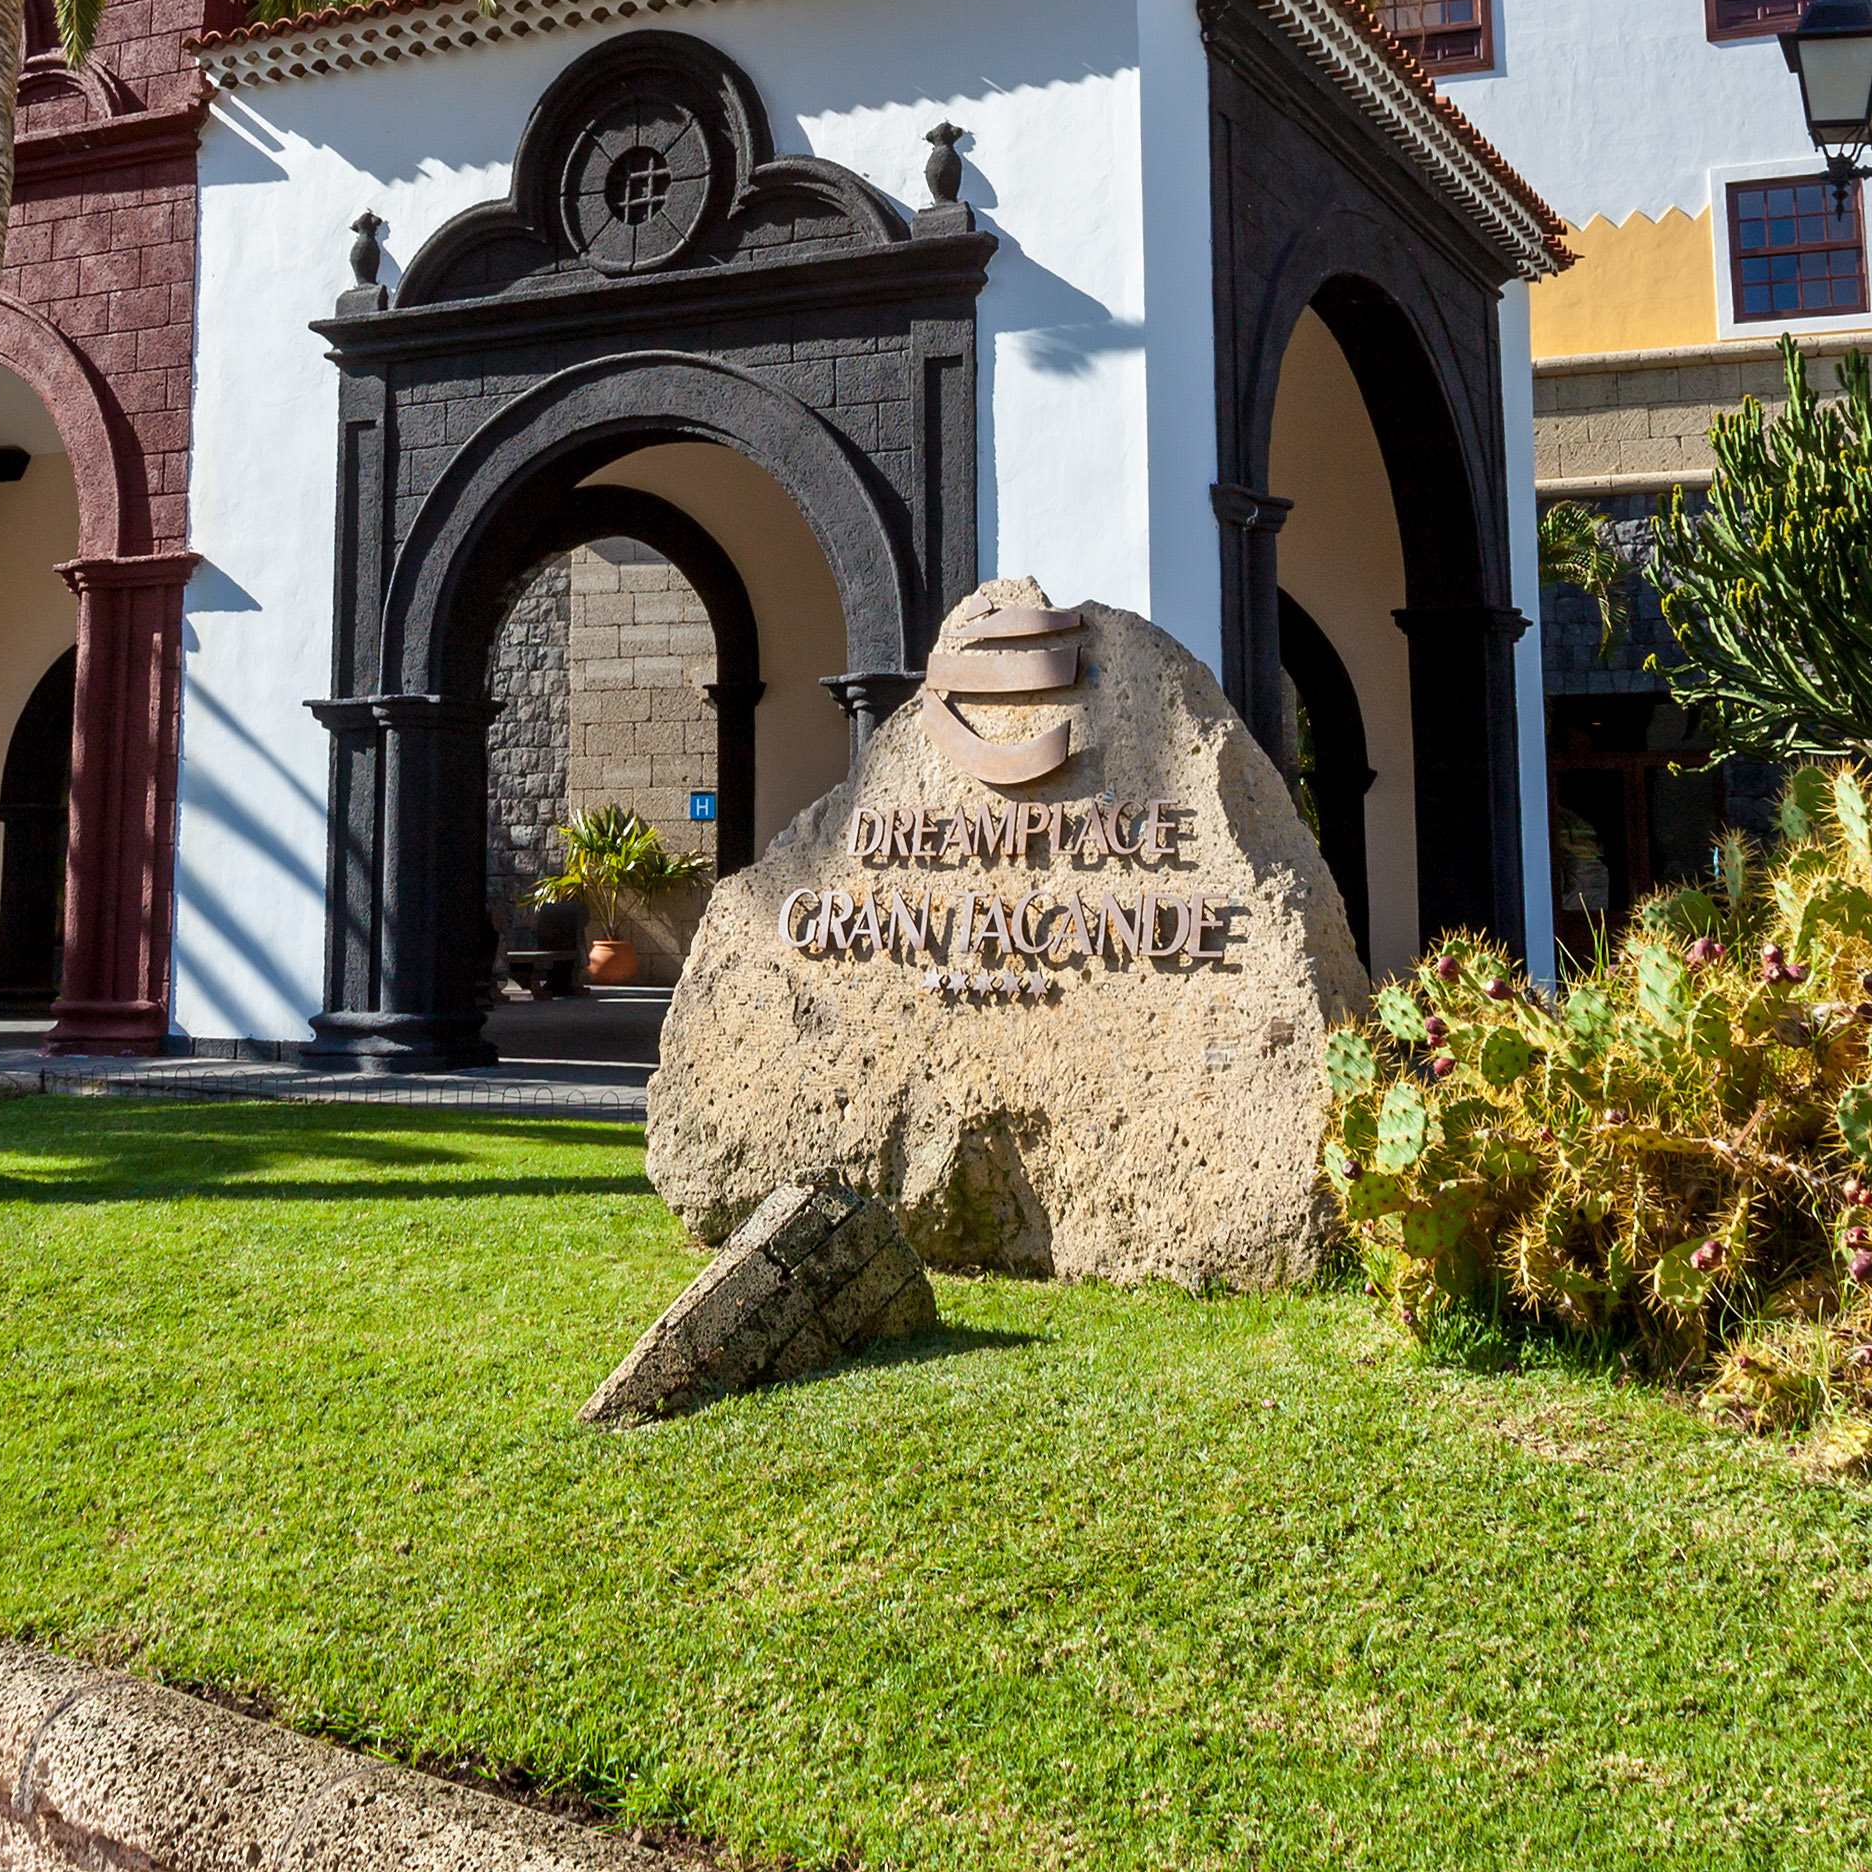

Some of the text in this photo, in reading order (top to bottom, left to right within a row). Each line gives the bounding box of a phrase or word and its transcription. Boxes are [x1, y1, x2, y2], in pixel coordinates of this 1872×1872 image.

[696, 798, 709, 816] H
[846, 799, 1179, 857] DREAMPLACE
[778, 888, 1228, 959] GRAN TACANDE
